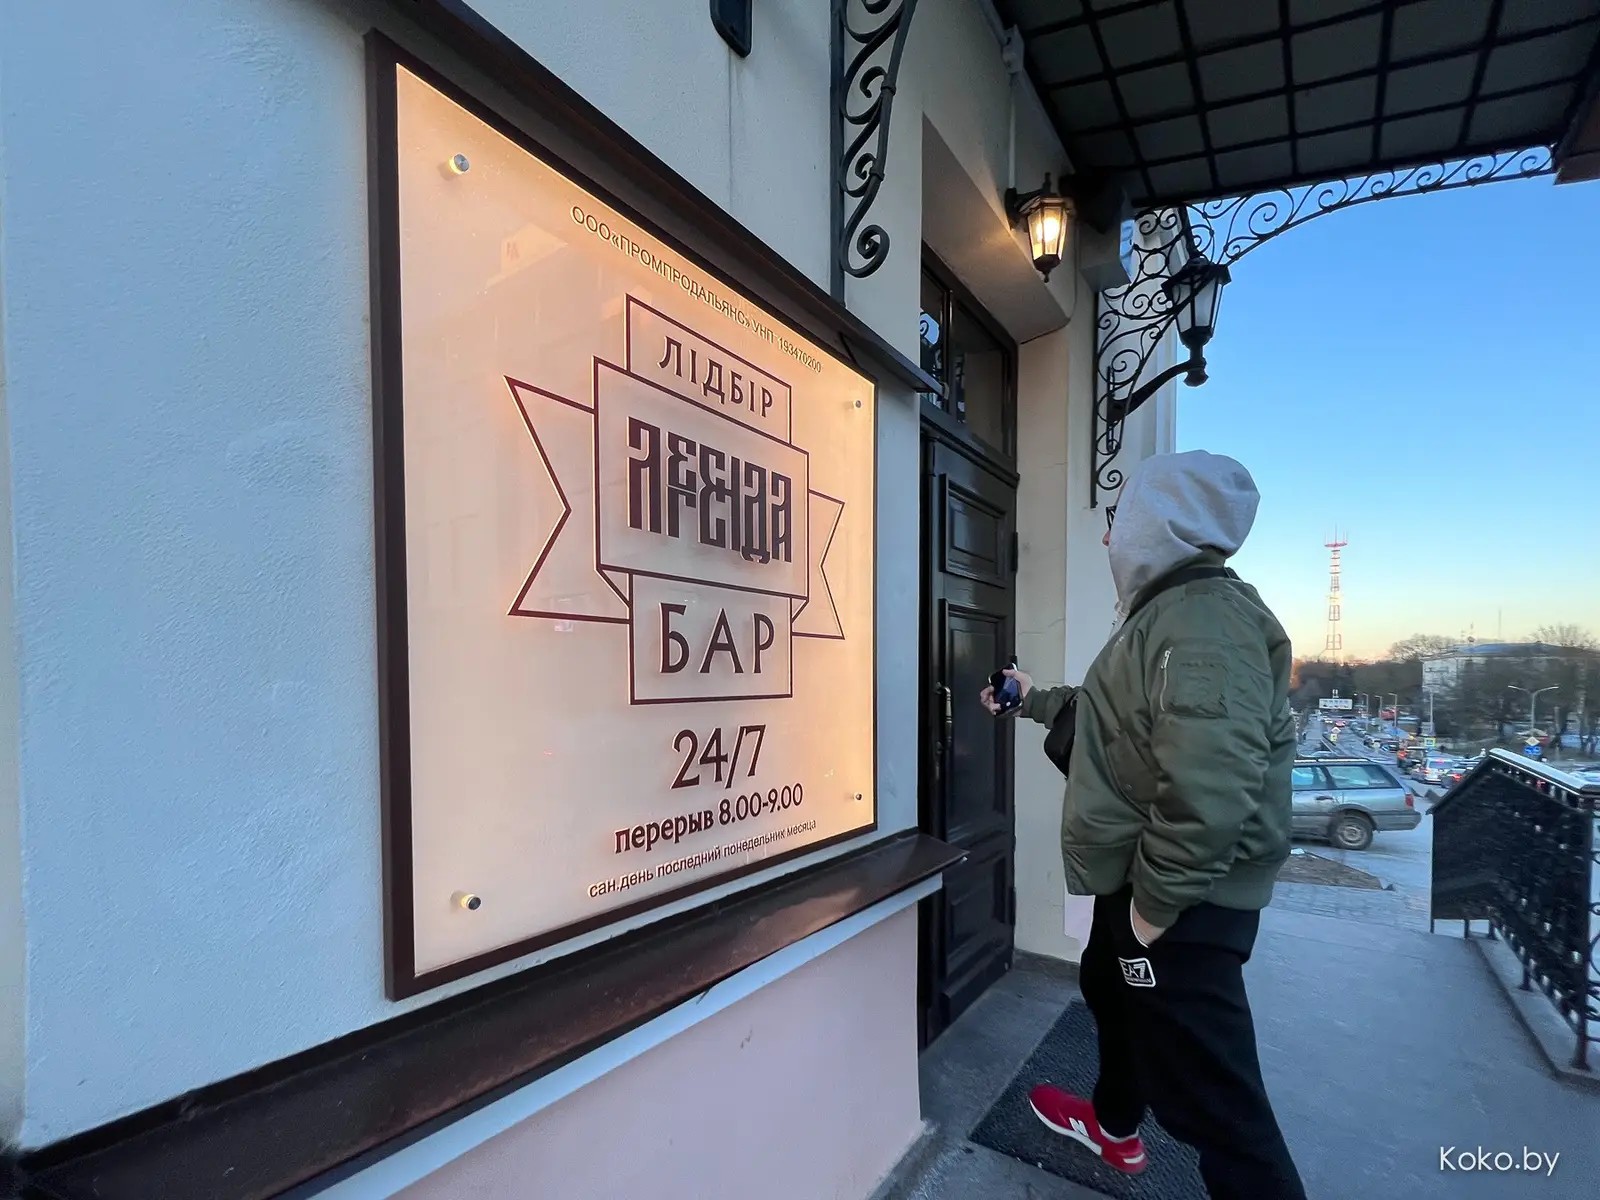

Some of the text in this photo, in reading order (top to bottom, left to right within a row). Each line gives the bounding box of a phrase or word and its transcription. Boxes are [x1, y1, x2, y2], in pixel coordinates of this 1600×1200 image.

[658, 336, 773, 417] ЛІДБІР
[752, 319, 774, 344] УНП
[778, 337, 822, 373] 193470200
[628, 416, 792, 564] ЛЕГЕНДА
[660, 602, 775, 674] БАР
[670, 724, 766, 789] 24/7
[615, 783, 804, 854] перерыв 8.00-9.00
[588, 819, 817, 898] сан.день последний понедельник месяца
